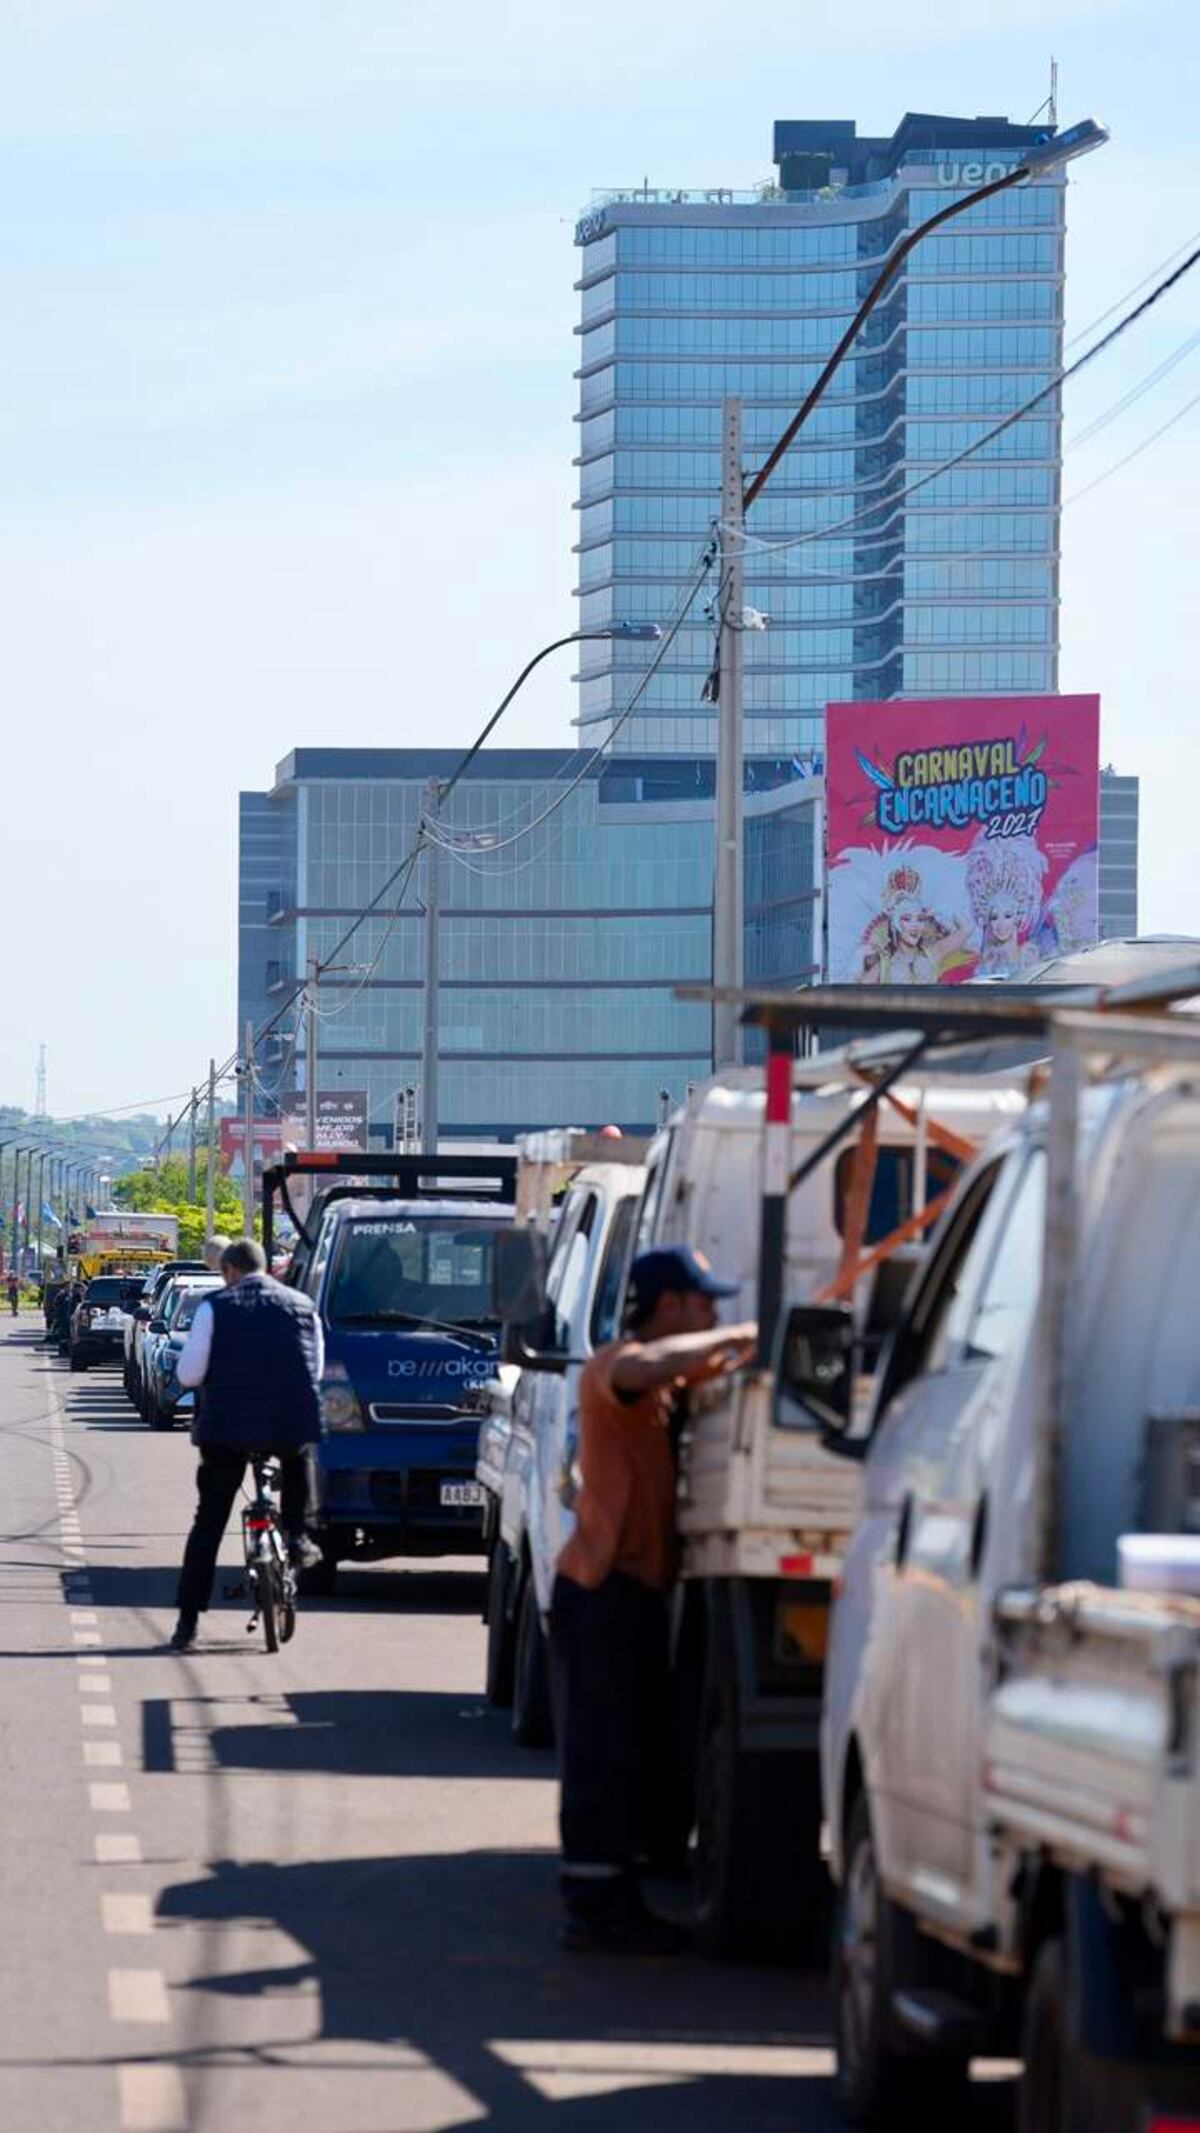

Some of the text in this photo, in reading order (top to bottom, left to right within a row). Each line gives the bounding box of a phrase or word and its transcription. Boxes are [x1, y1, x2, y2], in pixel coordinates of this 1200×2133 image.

[898, 741, 1020, 788] CARNAVAL
[987, 807, 1043, 839] 2027
[352, 1222, 417, 1235] PRENSA
